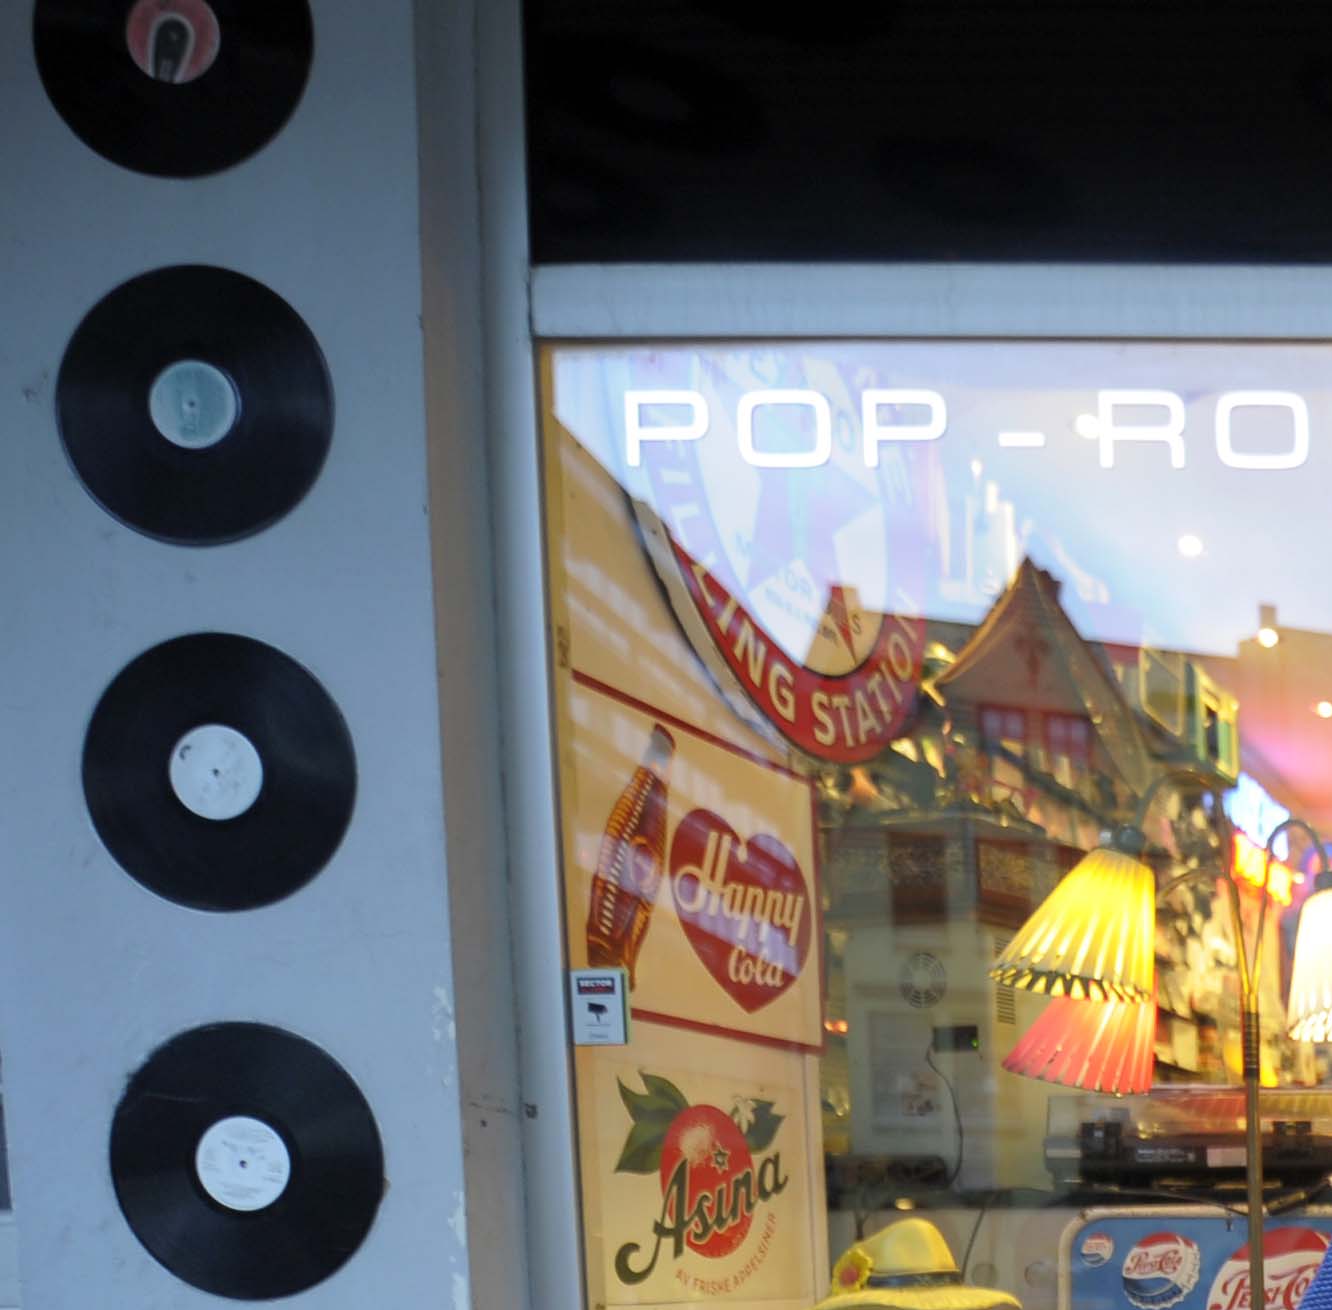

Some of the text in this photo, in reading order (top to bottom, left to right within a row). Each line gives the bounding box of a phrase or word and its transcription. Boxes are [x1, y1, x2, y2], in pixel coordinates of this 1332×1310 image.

[625, 390, 947, 469] POP
[673, 829, 804, 946] Happy
[729, 950, 784, 987] Cola
[614, 1151, 788, 1286] Asina
